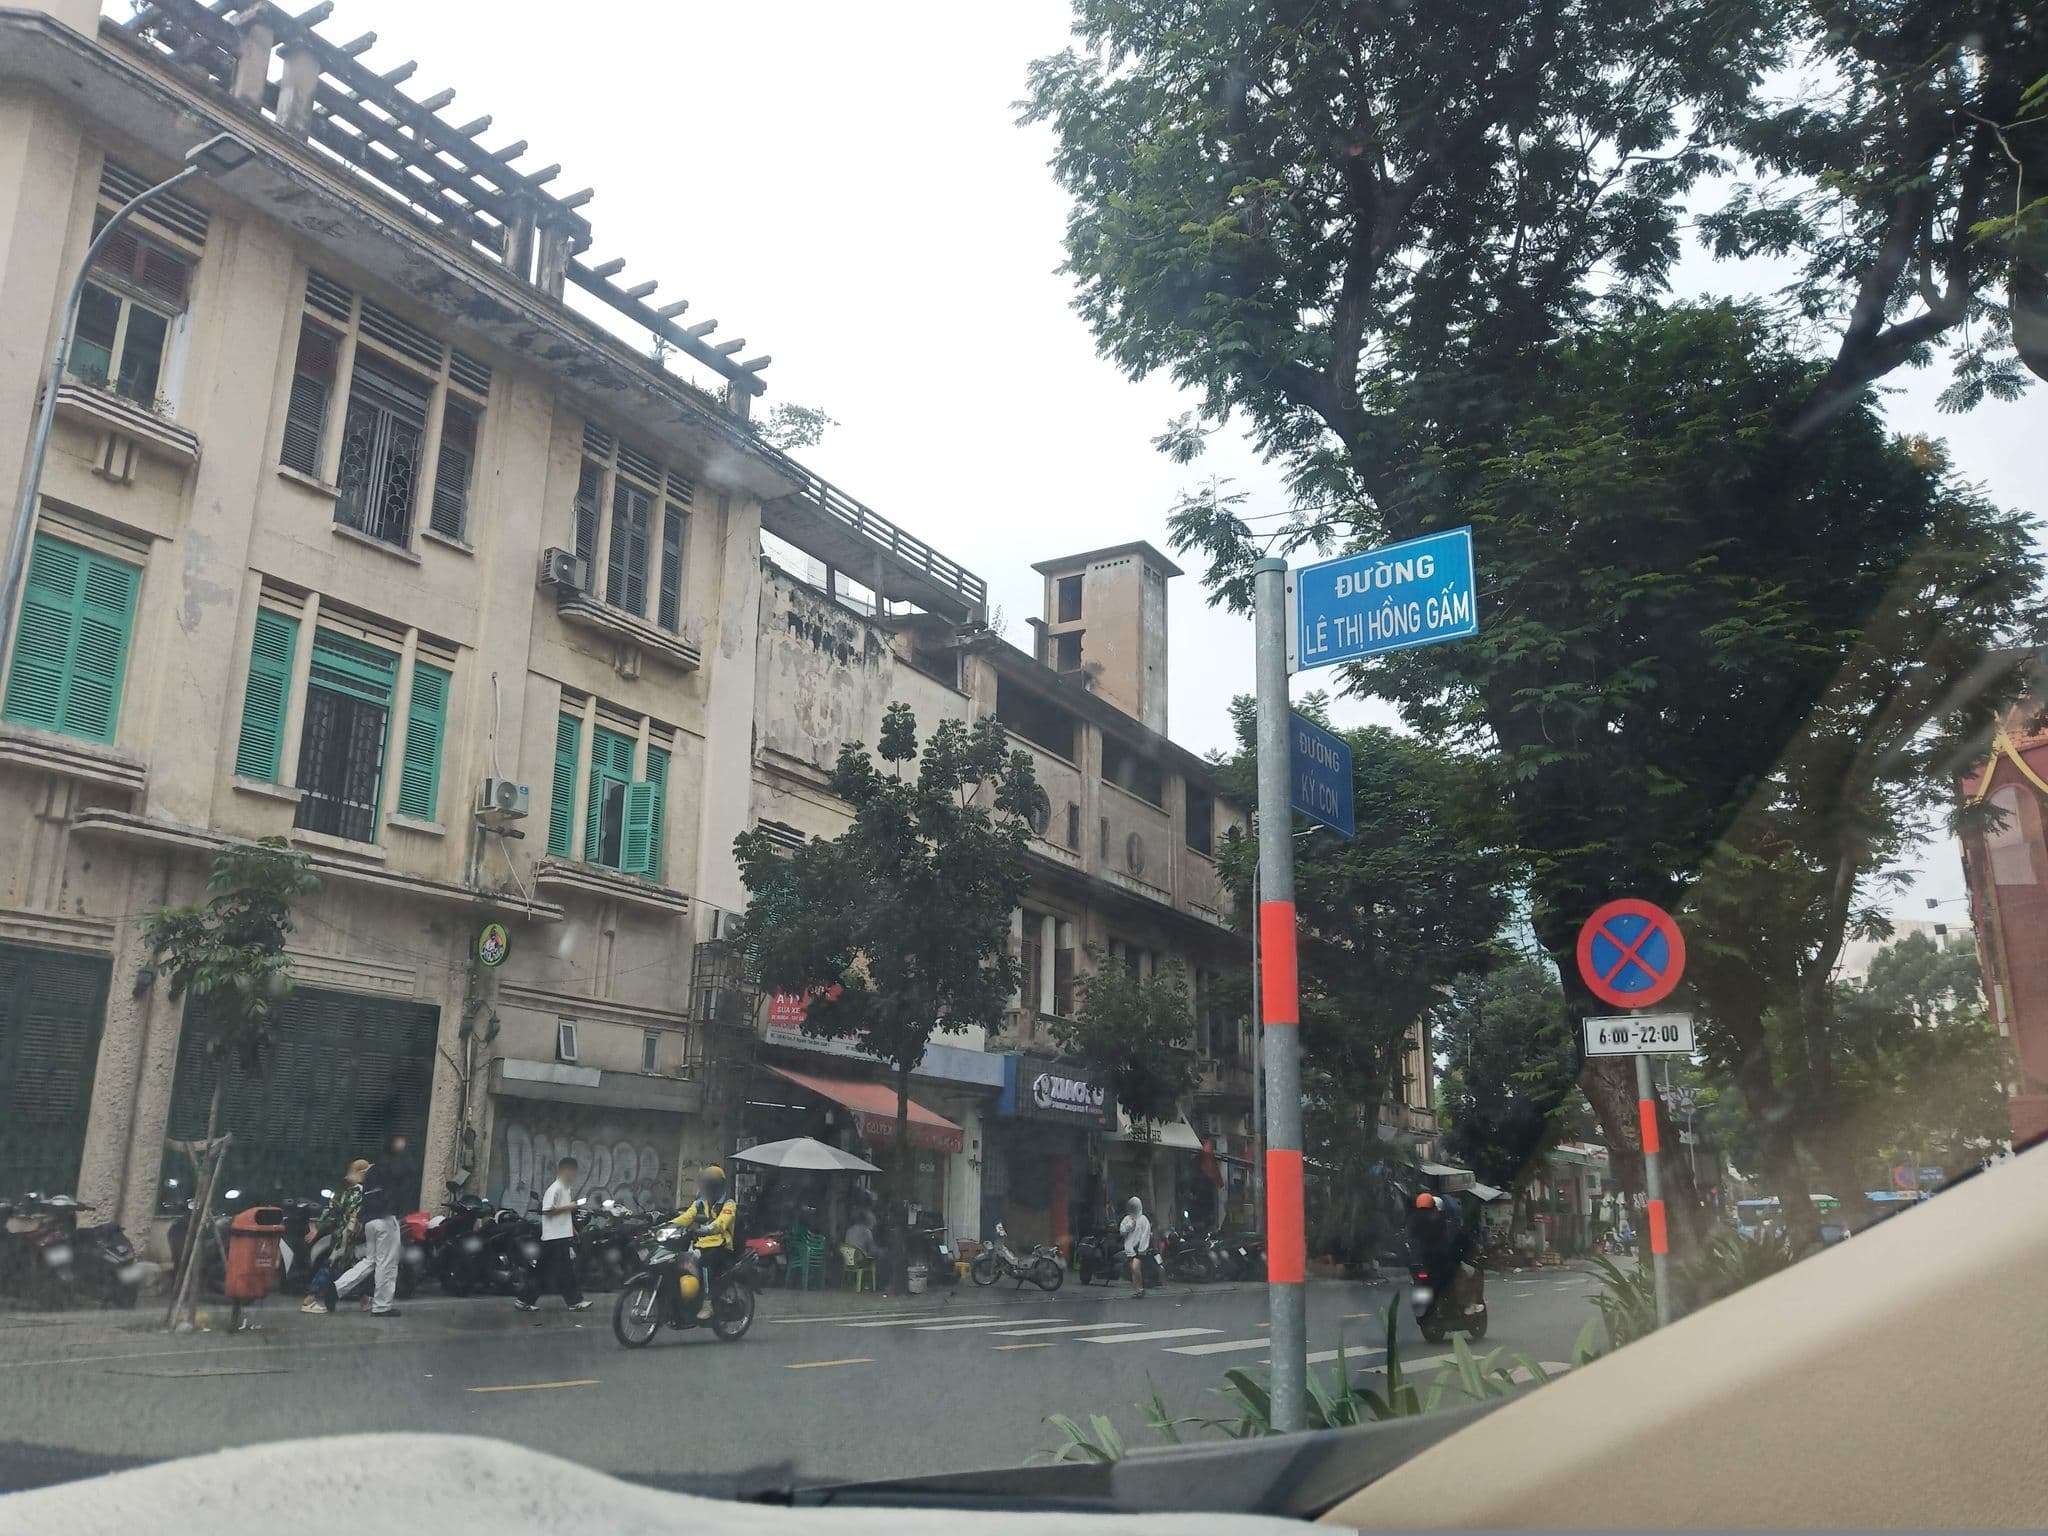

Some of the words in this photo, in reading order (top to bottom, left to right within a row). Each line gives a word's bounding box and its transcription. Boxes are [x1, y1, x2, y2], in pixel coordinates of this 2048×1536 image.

[1334, 554, 1435, 599] ĐƯỜNG
[1305, 614, 1328, 655] LÊ
[1333, 612, 1364, 649] THỊ
[1367, 595, 1421, 642] HỒNG
[1426, 581, 1470, 629] GẤM
[1299, 731, 1340, 773] ĐƯỜNG
[1301, 768, 1316, 806] KÝ
[1319, 783, 1339, 818] CON
